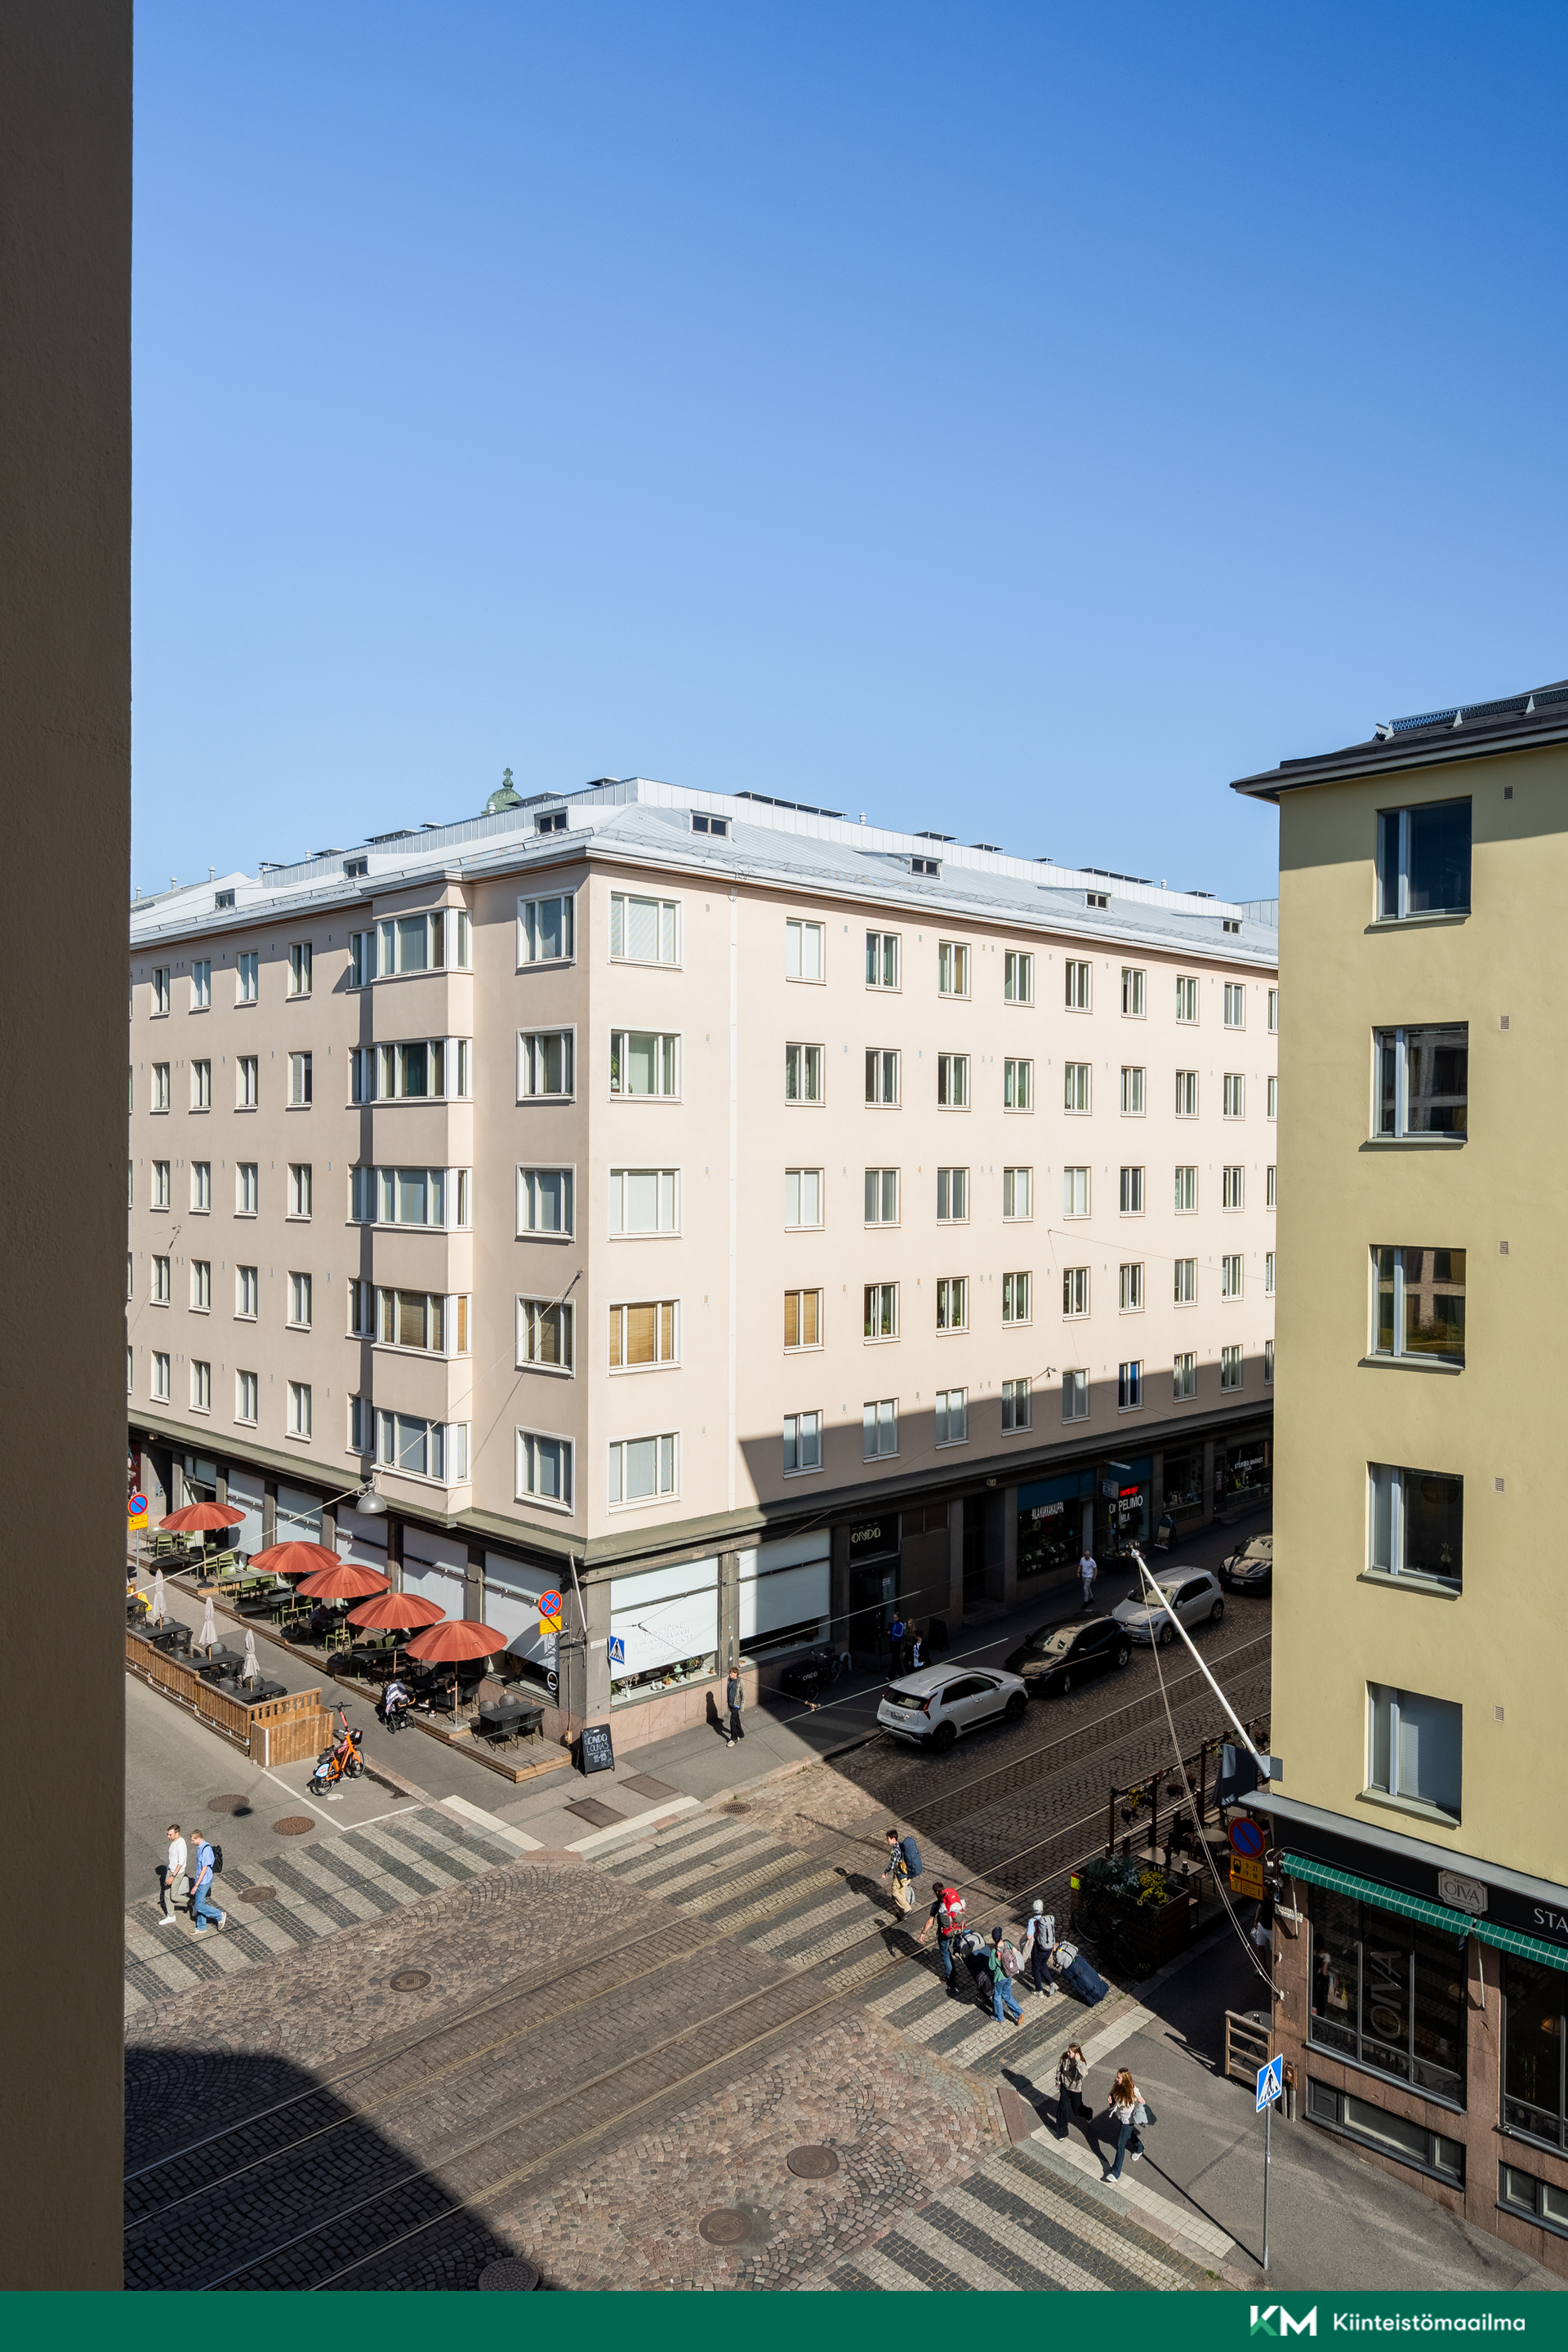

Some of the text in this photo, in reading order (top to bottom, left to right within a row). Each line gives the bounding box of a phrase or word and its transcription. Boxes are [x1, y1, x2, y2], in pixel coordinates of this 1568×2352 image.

[1250, 1456, 1263, 1465] MARKET
[851, 1527, 881, 1544] ONDO
[667, 1621, 684, 1631] DINE
[667, 1627, 689, 1638] LUNCH
[667, 1633, 694, 1646] EVENTS
[588, 1733, 608, 1745] ONDO
[586, 1741, 609, 1753] LOUNAS
[1454, 1878, 1470, 1886] KALLION
[1444, 1881, 1481, 1904] OIVA
[1534, 1908, 1568, 1934] STA
[1370, 1951, 1402, 2039] OIVA
